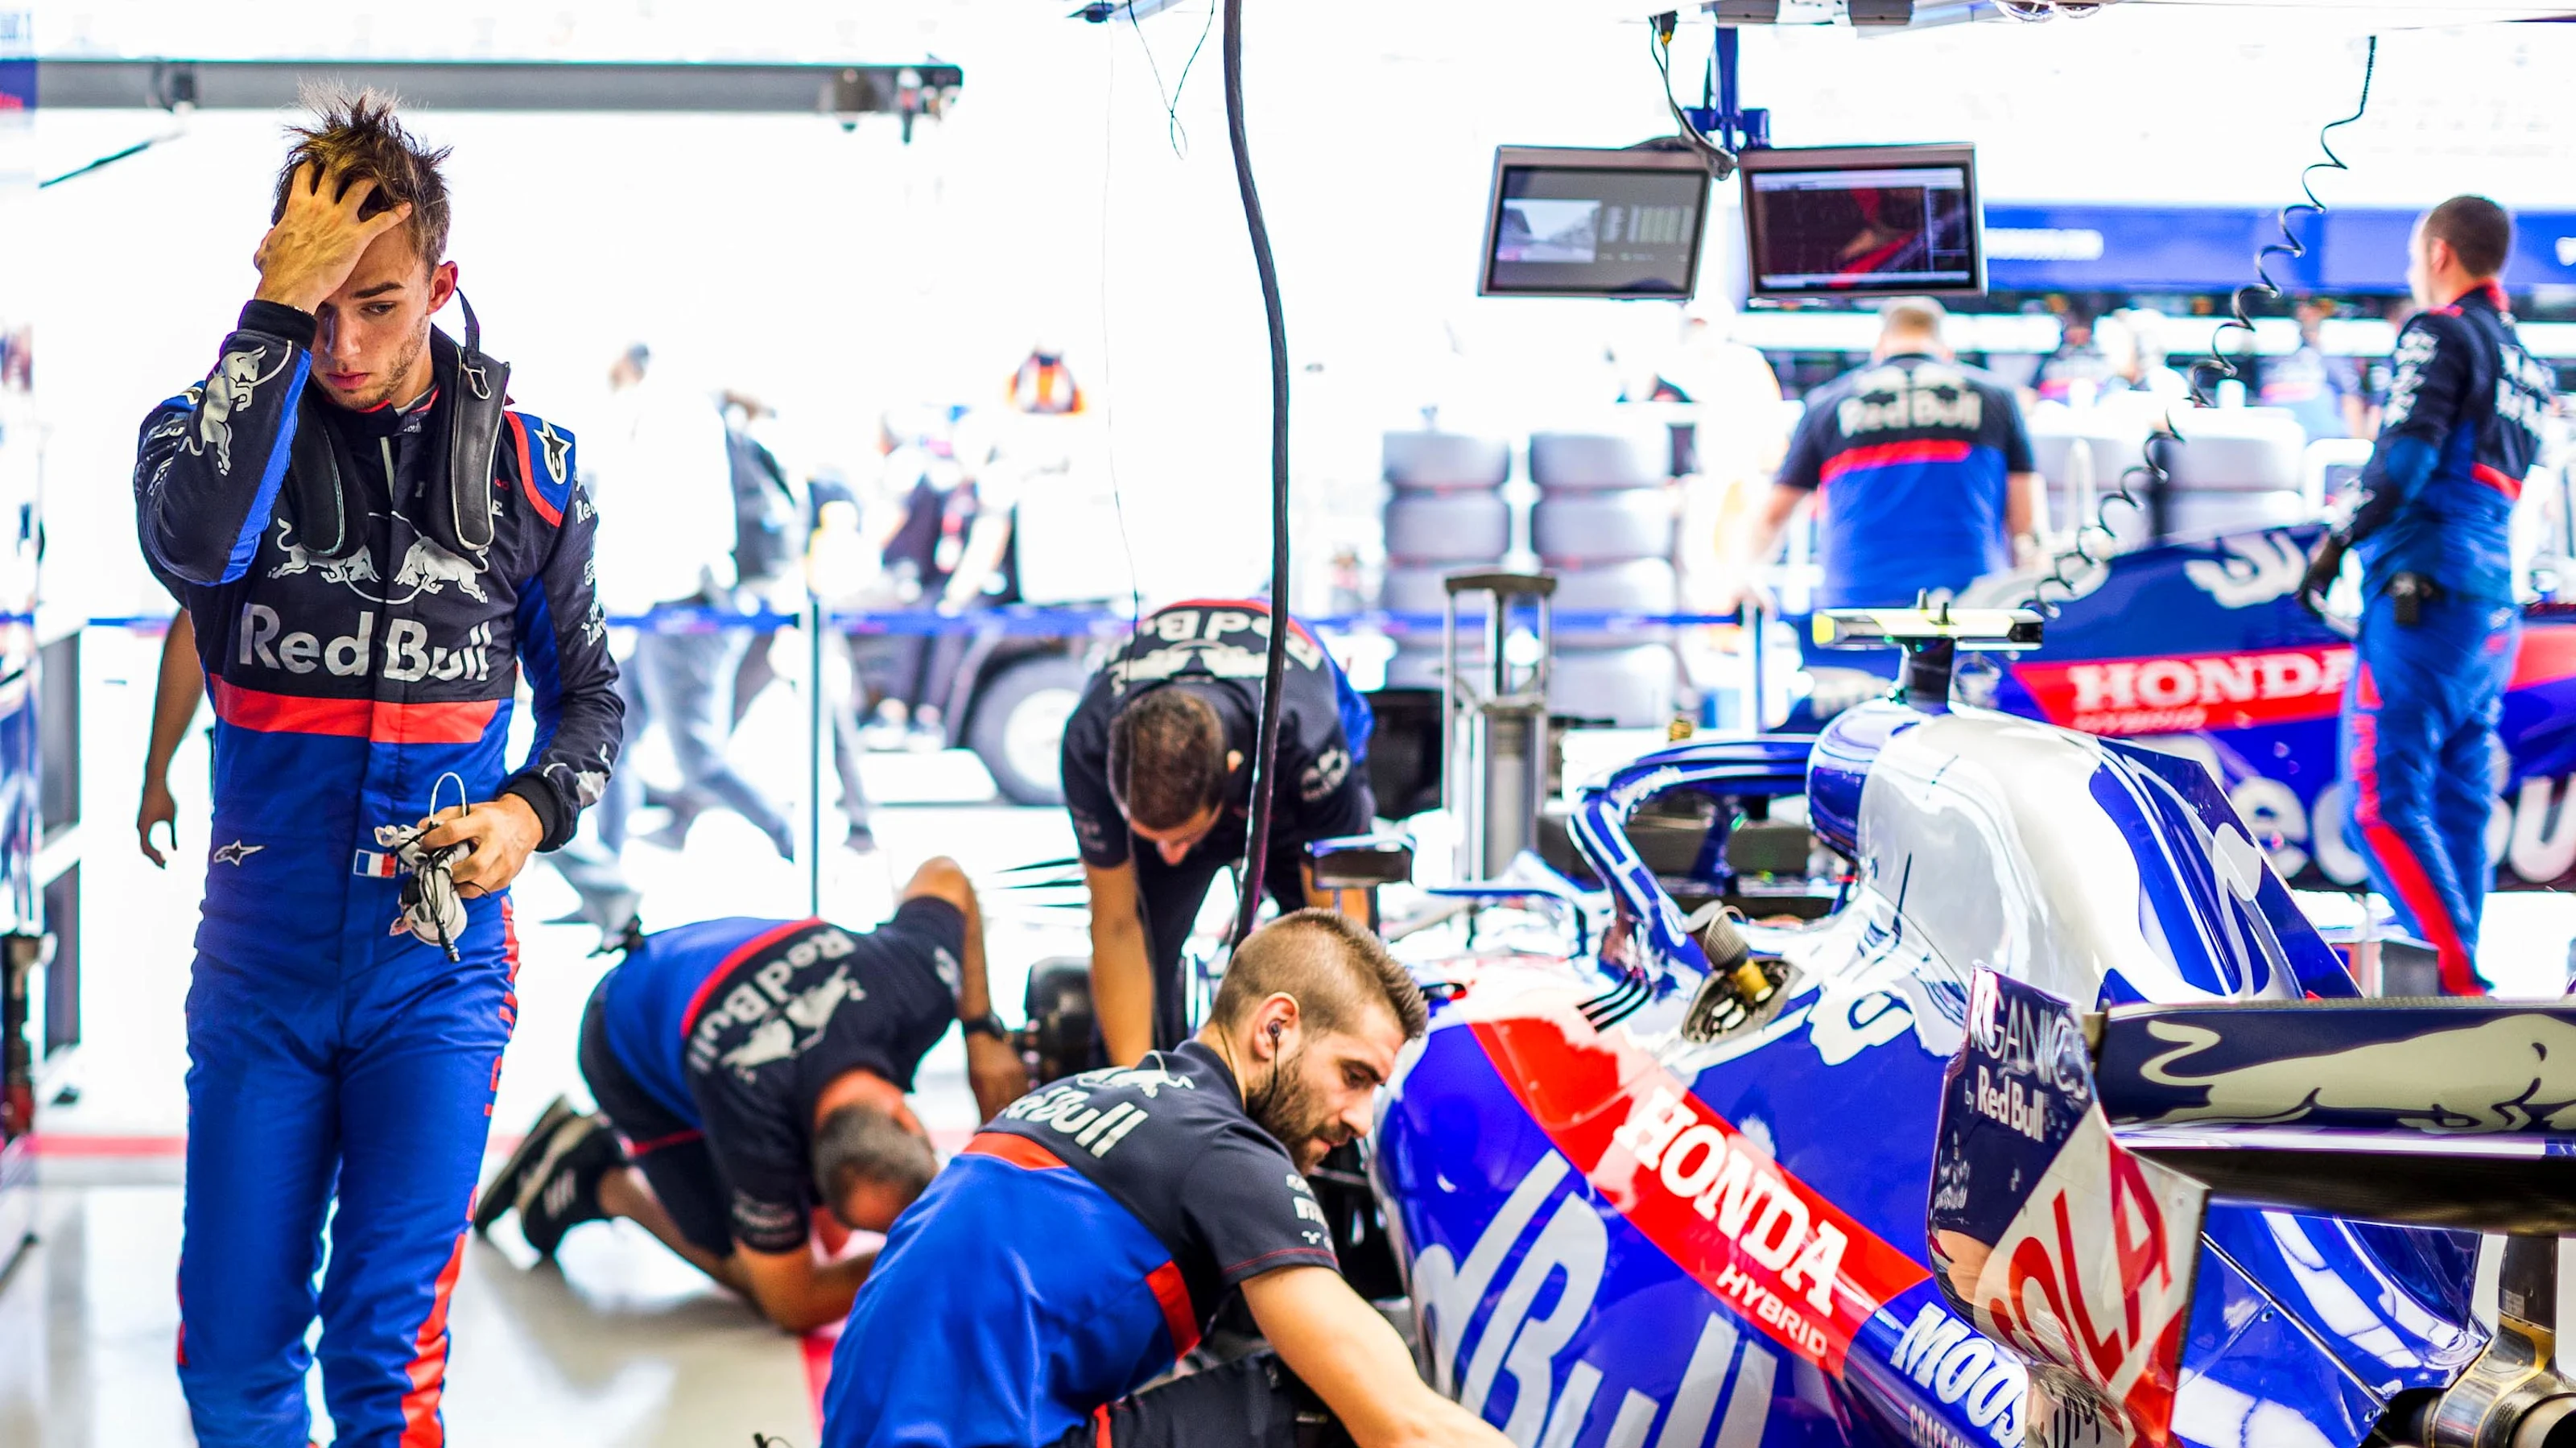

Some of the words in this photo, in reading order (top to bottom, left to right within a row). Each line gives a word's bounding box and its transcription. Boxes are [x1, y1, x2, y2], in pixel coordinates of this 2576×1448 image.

[239, 602, 374, 676] Red
[383, 617, 493, 683] Bull
[754, 929, 856, 1005] Red
[688, 983, 770, 1073] Bull
[1977, 1064, 2011, 1124] Red
[2011, 1082, 2045, 1143] Bull
[1612, 1085, 1848, 1318] HONDA
[1699, 1262, 1828, 1350] HYBRID
[1889, 1301, 2027, 1448] MOOS
